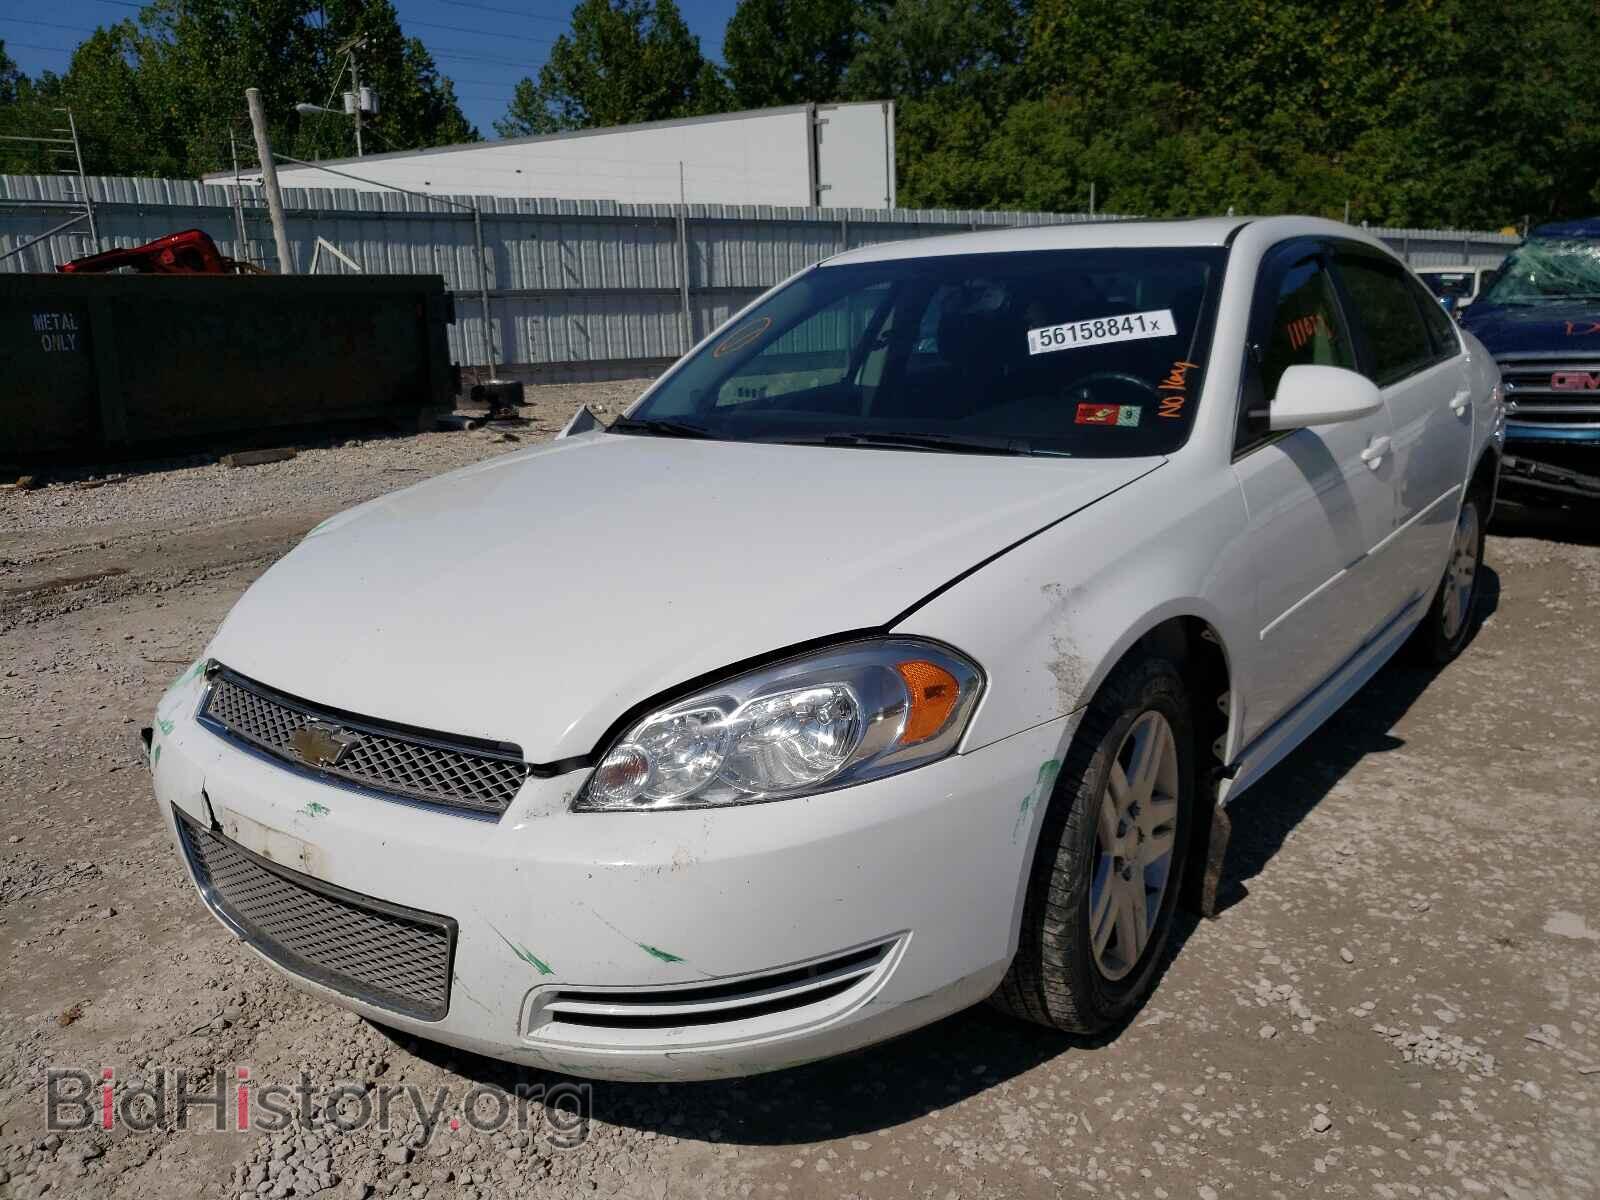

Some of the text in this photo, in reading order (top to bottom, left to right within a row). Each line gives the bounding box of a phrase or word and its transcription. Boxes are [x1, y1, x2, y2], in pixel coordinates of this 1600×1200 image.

[32, 312, 79, 331] METAL
[1039, 315, 1147, 347] 56158841
[41, 333, 76, 352] ONLY
